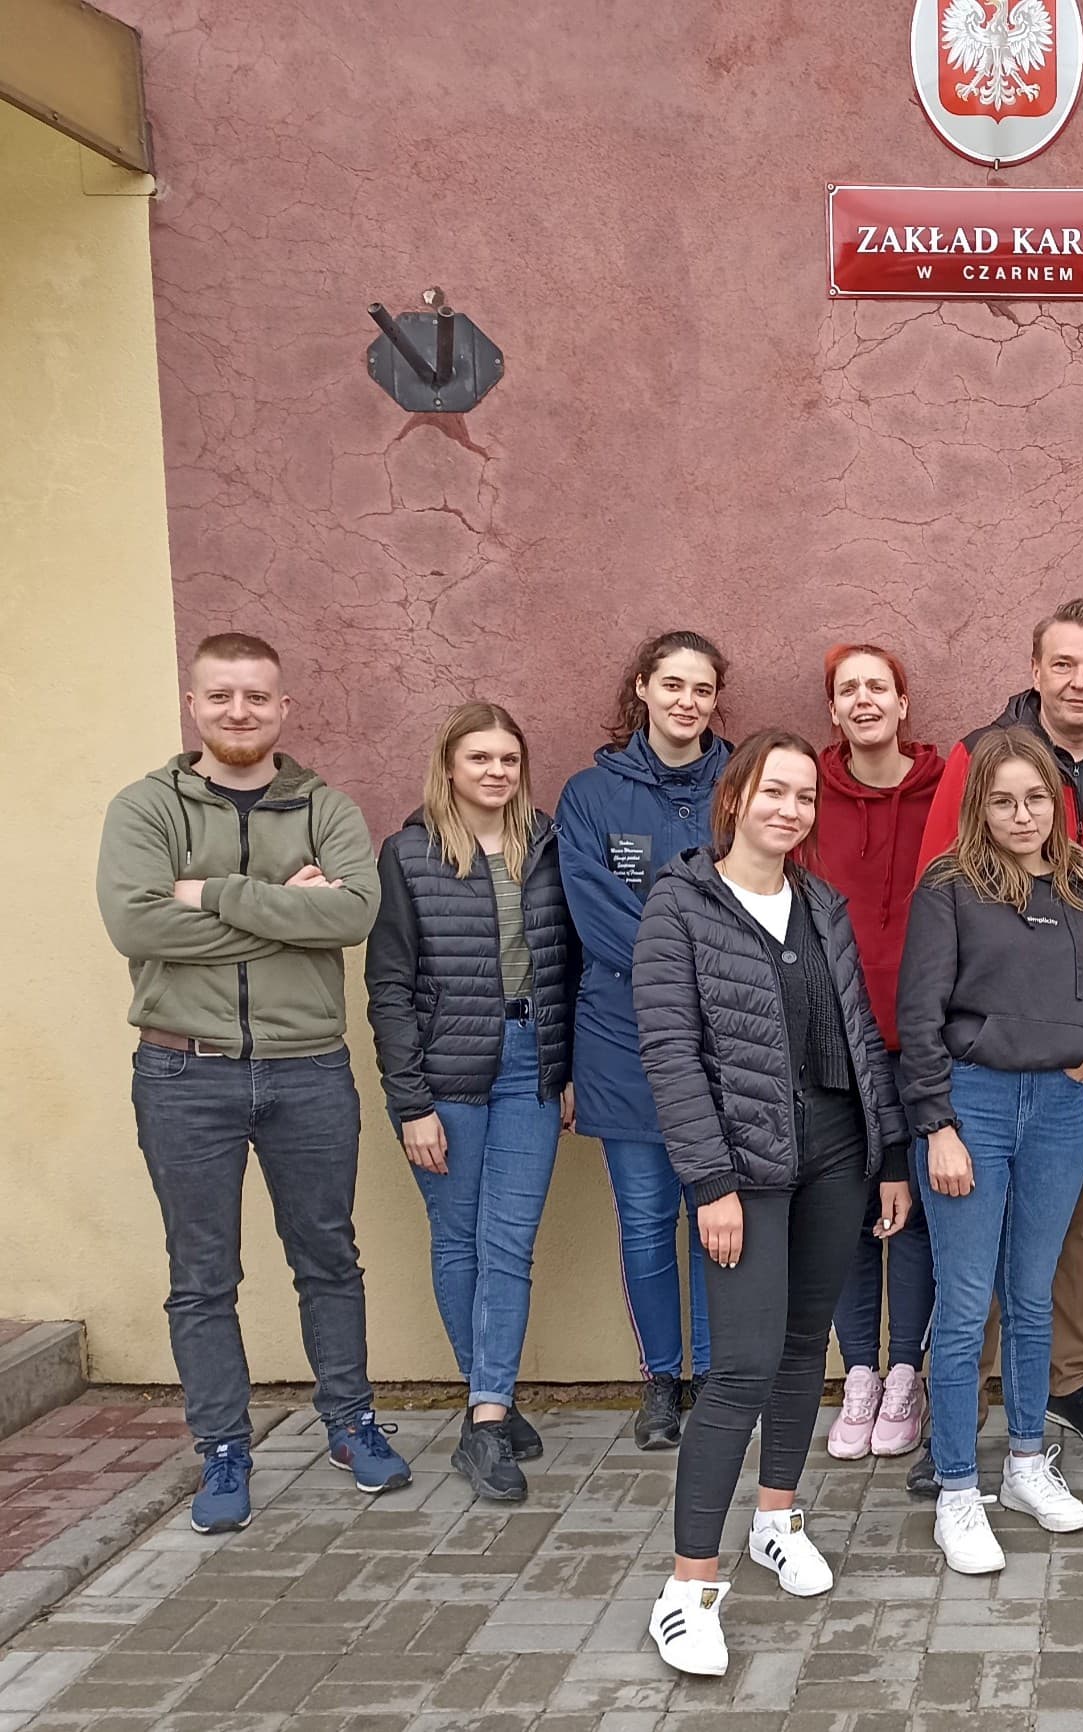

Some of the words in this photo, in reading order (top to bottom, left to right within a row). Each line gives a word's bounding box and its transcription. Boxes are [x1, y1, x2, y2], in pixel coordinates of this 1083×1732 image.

[857, 227, 999, 254] ZAKŁAD
[916, 265, 932, 279] W
[963, 265, 1073, 281] CZARNEM
